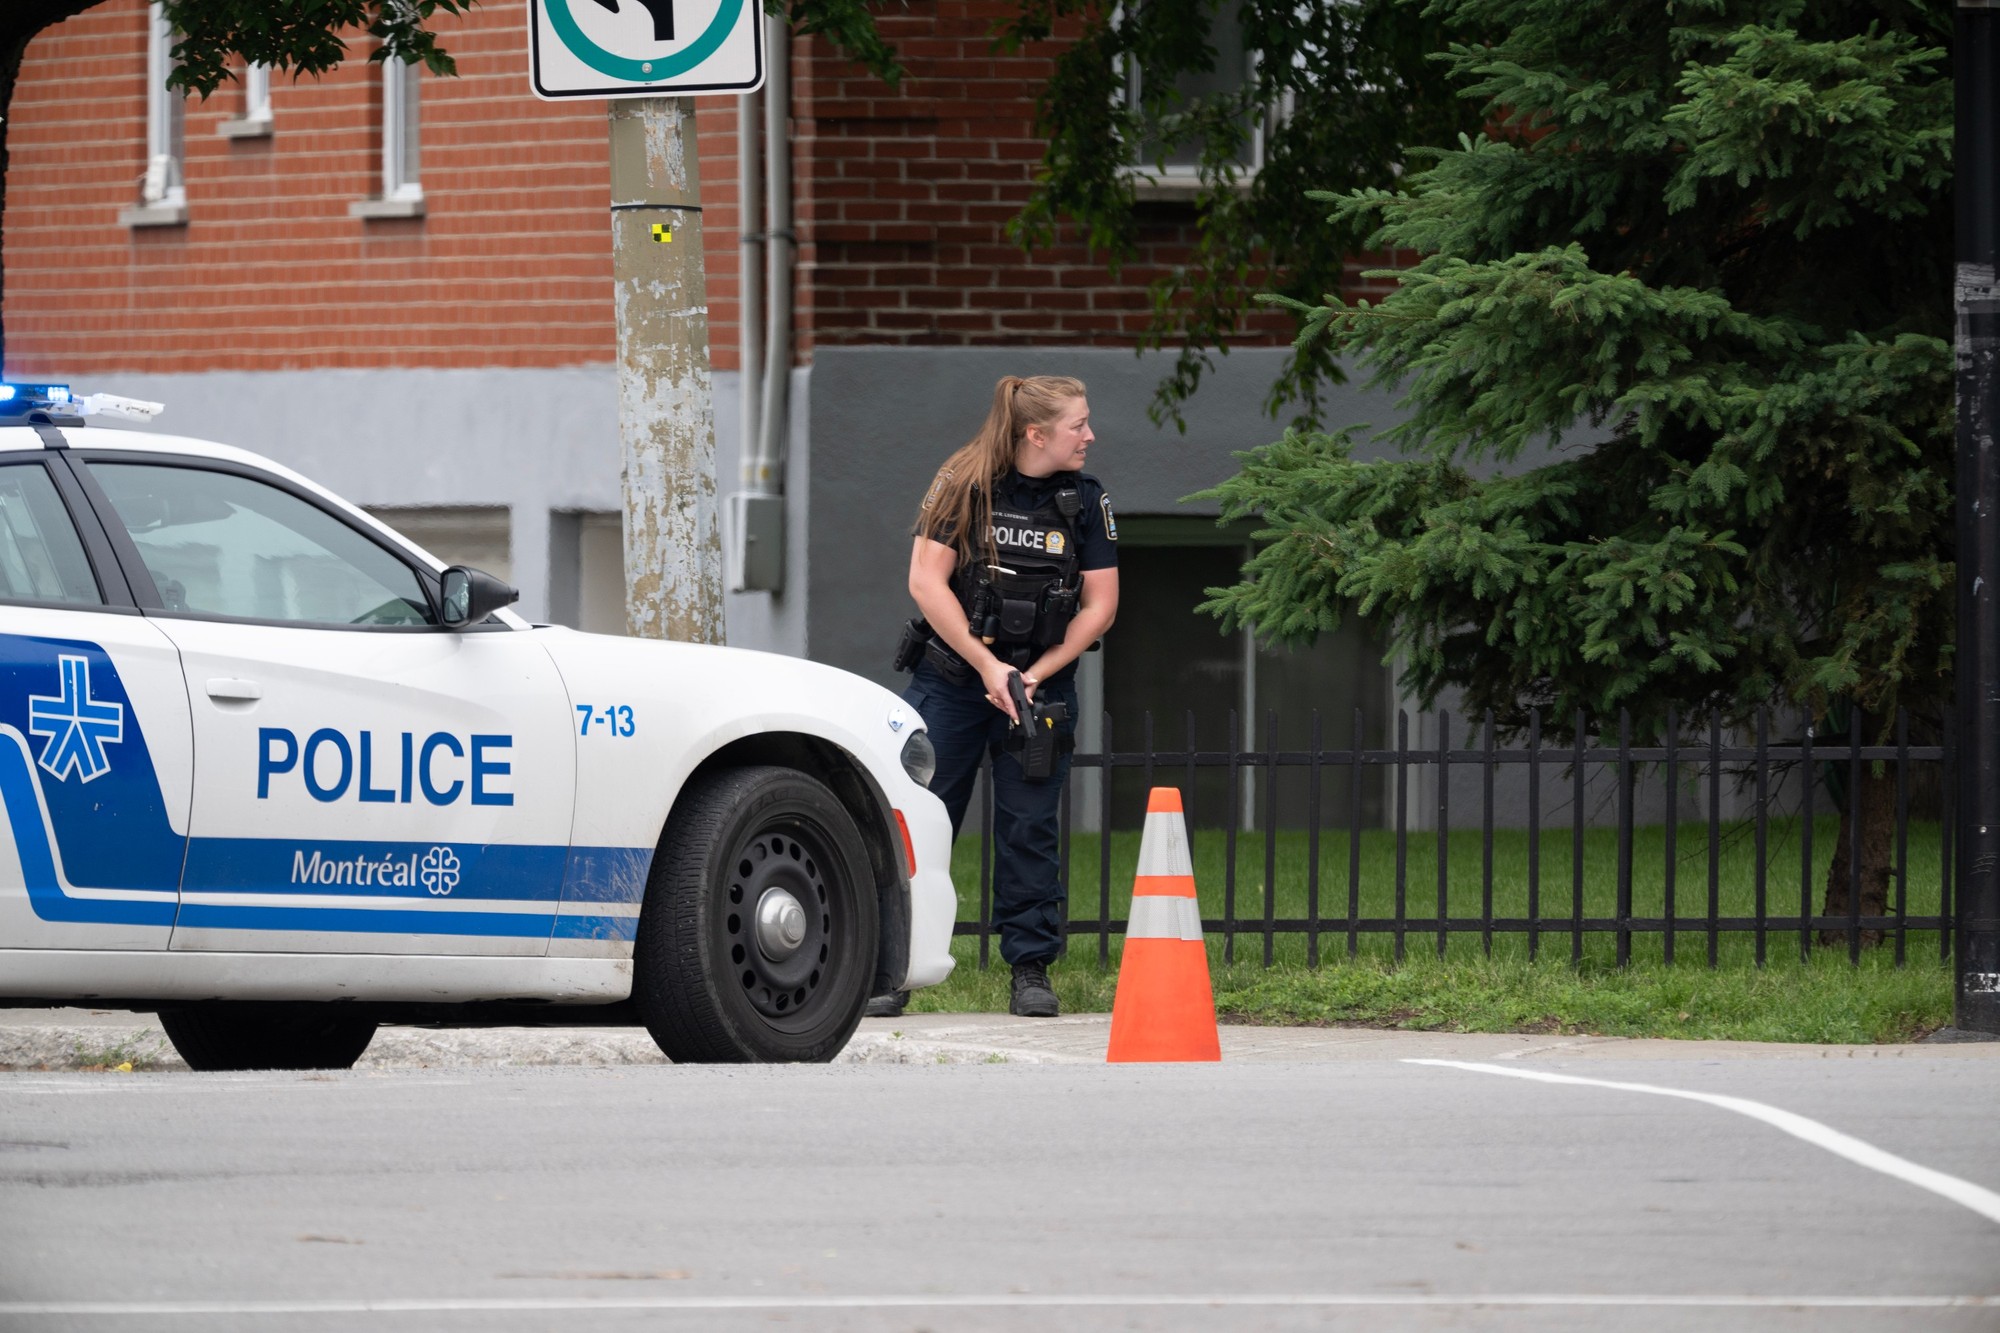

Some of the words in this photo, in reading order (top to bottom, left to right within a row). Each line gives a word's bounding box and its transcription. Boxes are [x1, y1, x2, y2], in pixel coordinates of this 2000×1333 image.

[985, 525, 1045, 549] POLICE
[577, 704, 636, 738] 7-13
[257, 727, 514, 806] POLICE
[291, 850, 417, 888] Montréal
